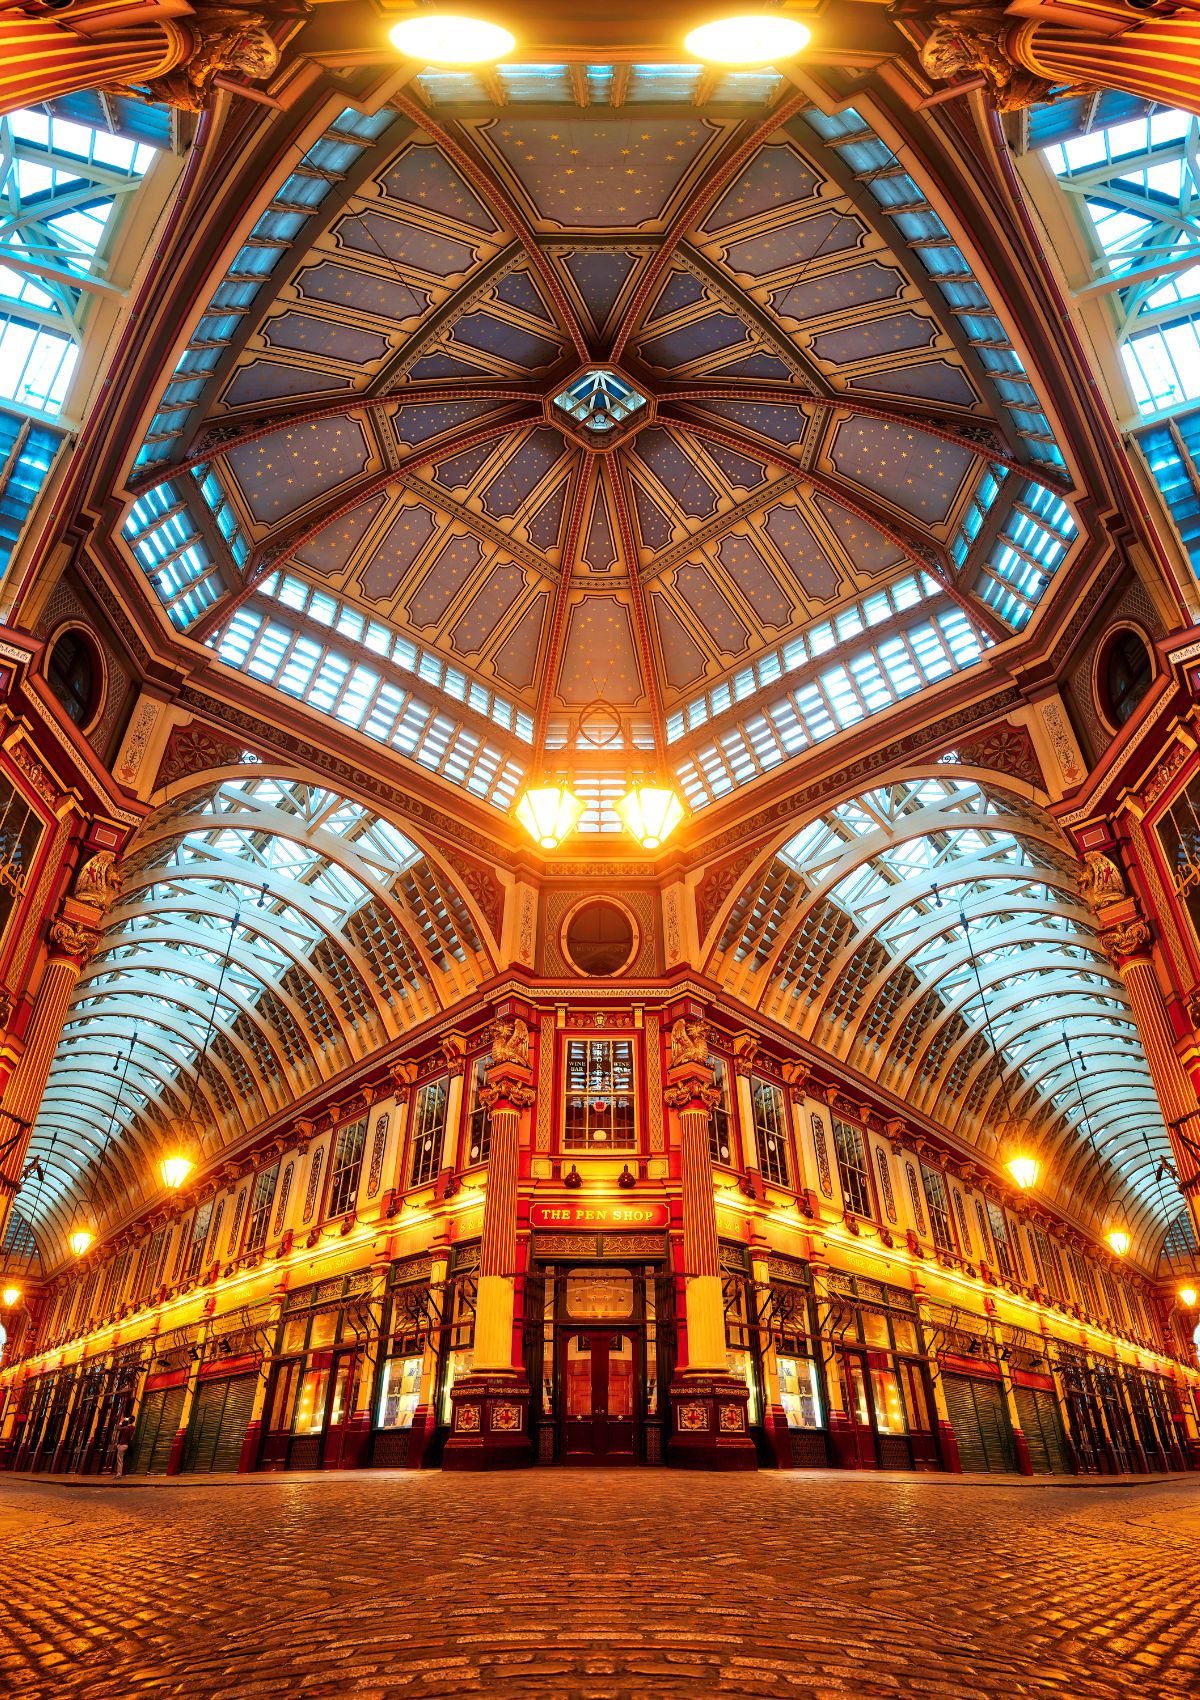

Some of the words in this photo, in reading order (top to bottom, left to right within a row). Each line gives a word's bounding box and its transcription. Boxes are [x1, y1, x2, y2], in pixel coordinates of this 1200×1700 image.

[541, 1209, 571, 1220] THE
[575, 1209, 607, 1220] PEN
[613, 1210, 654, 1221] SHOP
